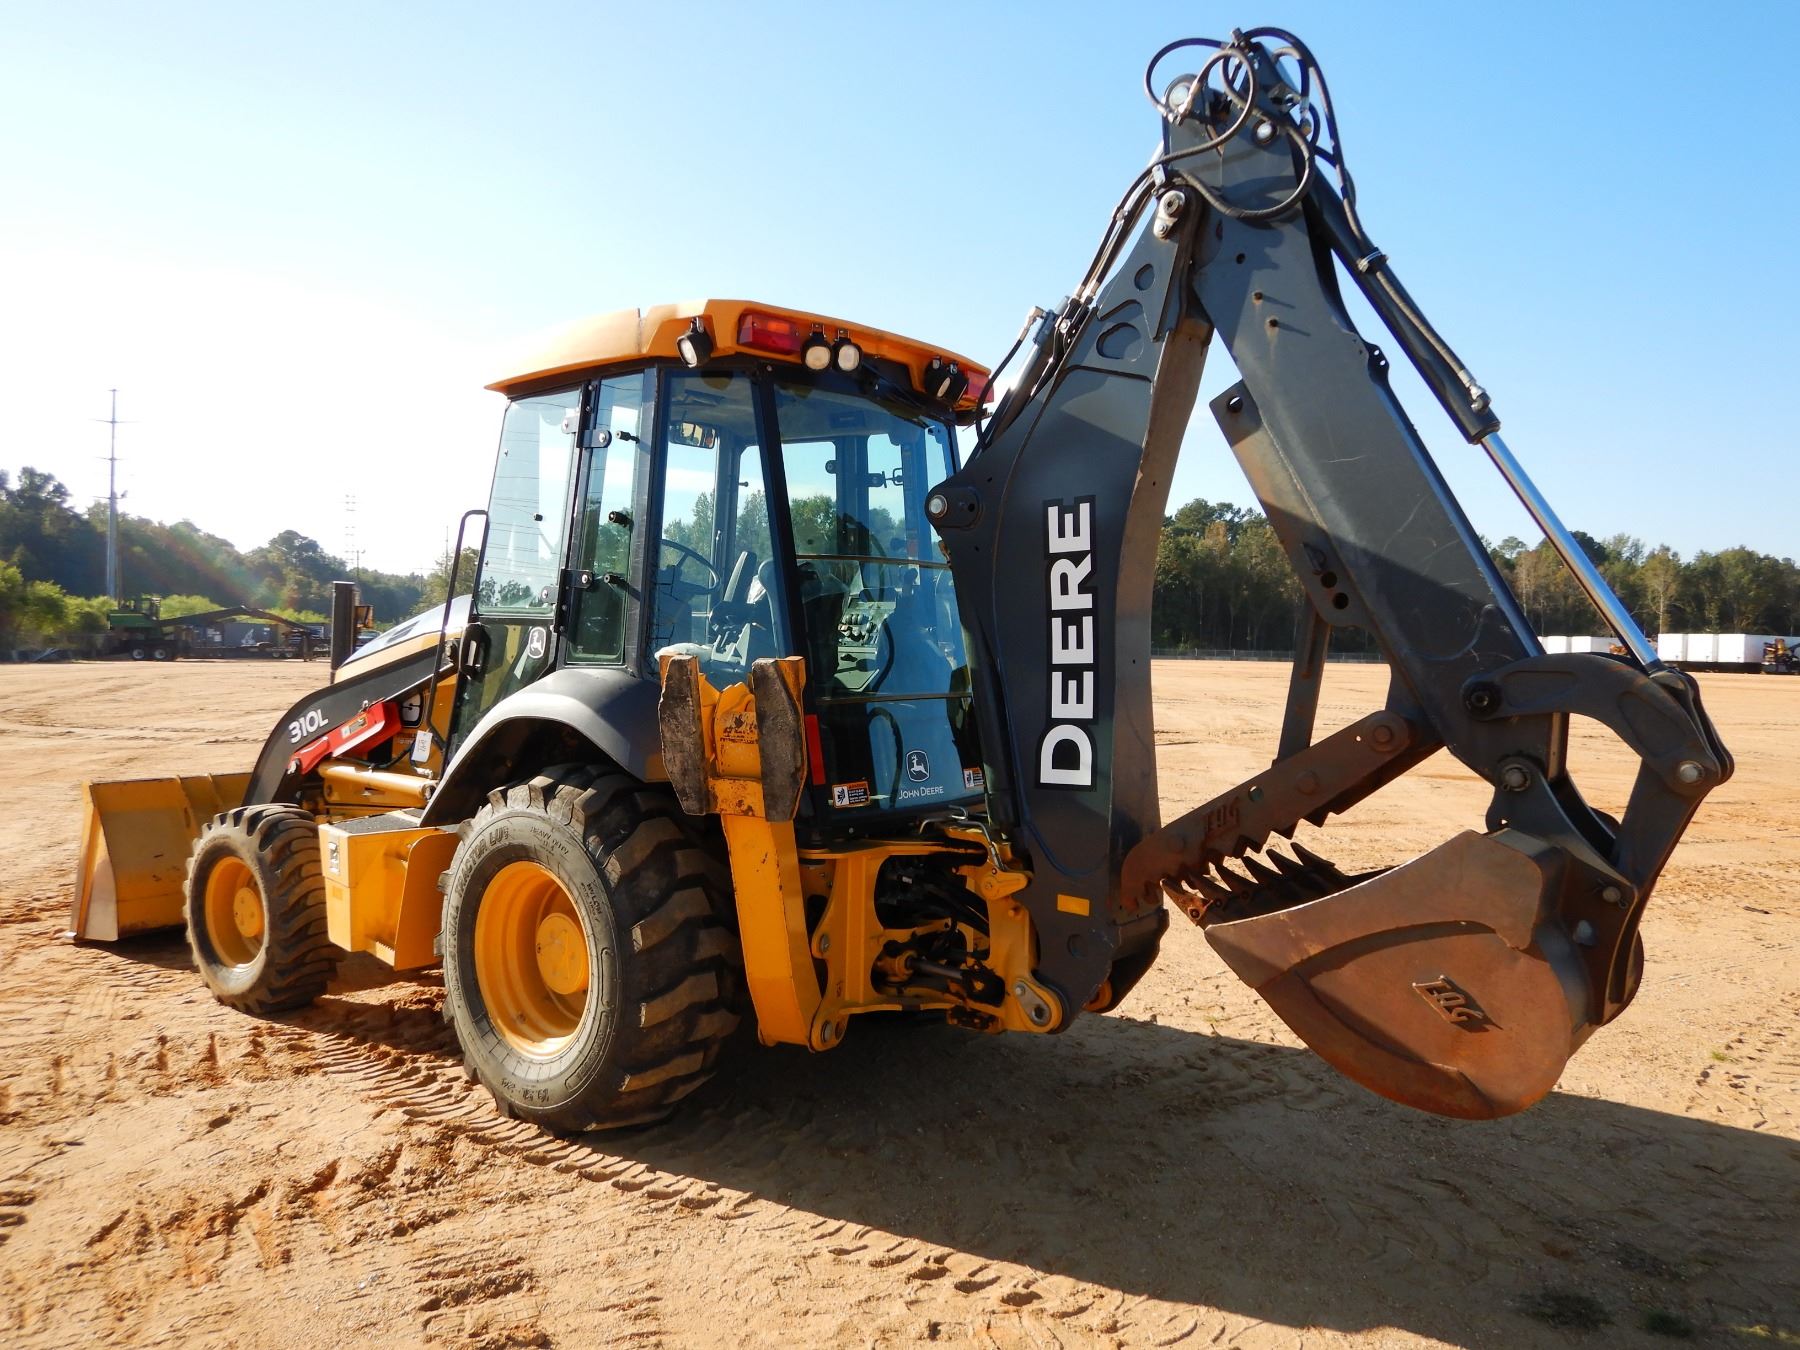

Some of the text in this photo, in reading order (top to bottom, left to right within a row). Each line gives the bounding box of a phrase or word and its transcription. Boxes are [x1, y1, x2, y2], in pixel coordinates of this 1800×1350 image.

[1040, 502, 1094, 786] DEERE
[288, 708, 329, 744] 310L
[898, 785, 945, 800] JOHN DEERE
